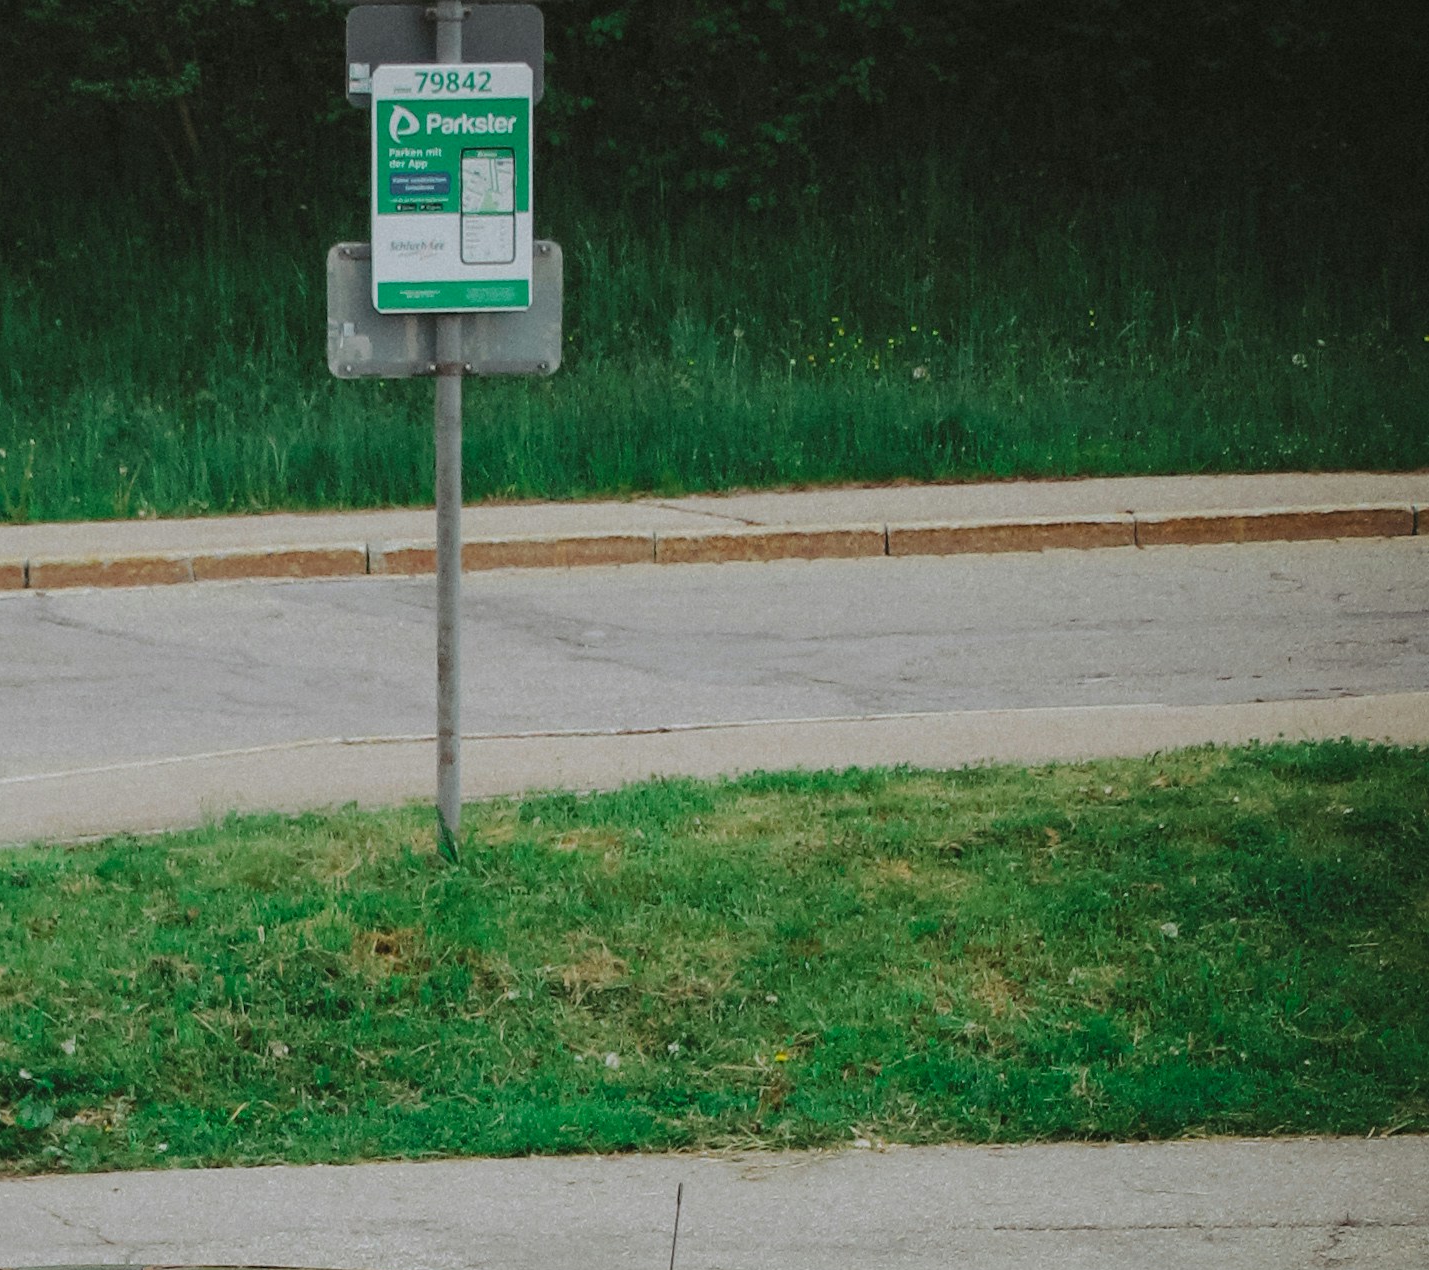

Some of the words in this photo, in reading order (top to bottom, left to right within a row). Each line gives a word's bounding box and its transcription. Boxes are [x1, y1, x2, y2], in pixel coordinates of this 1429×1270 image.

[414, 70, 492, 94] 79842
[426, 111, 517, 135] Parkster
[388, 147, 423, 158] Parken
[425, 147, 442, 158] mit
[388, 159, 406, 169] der
[408, 159, 428, 170] App
